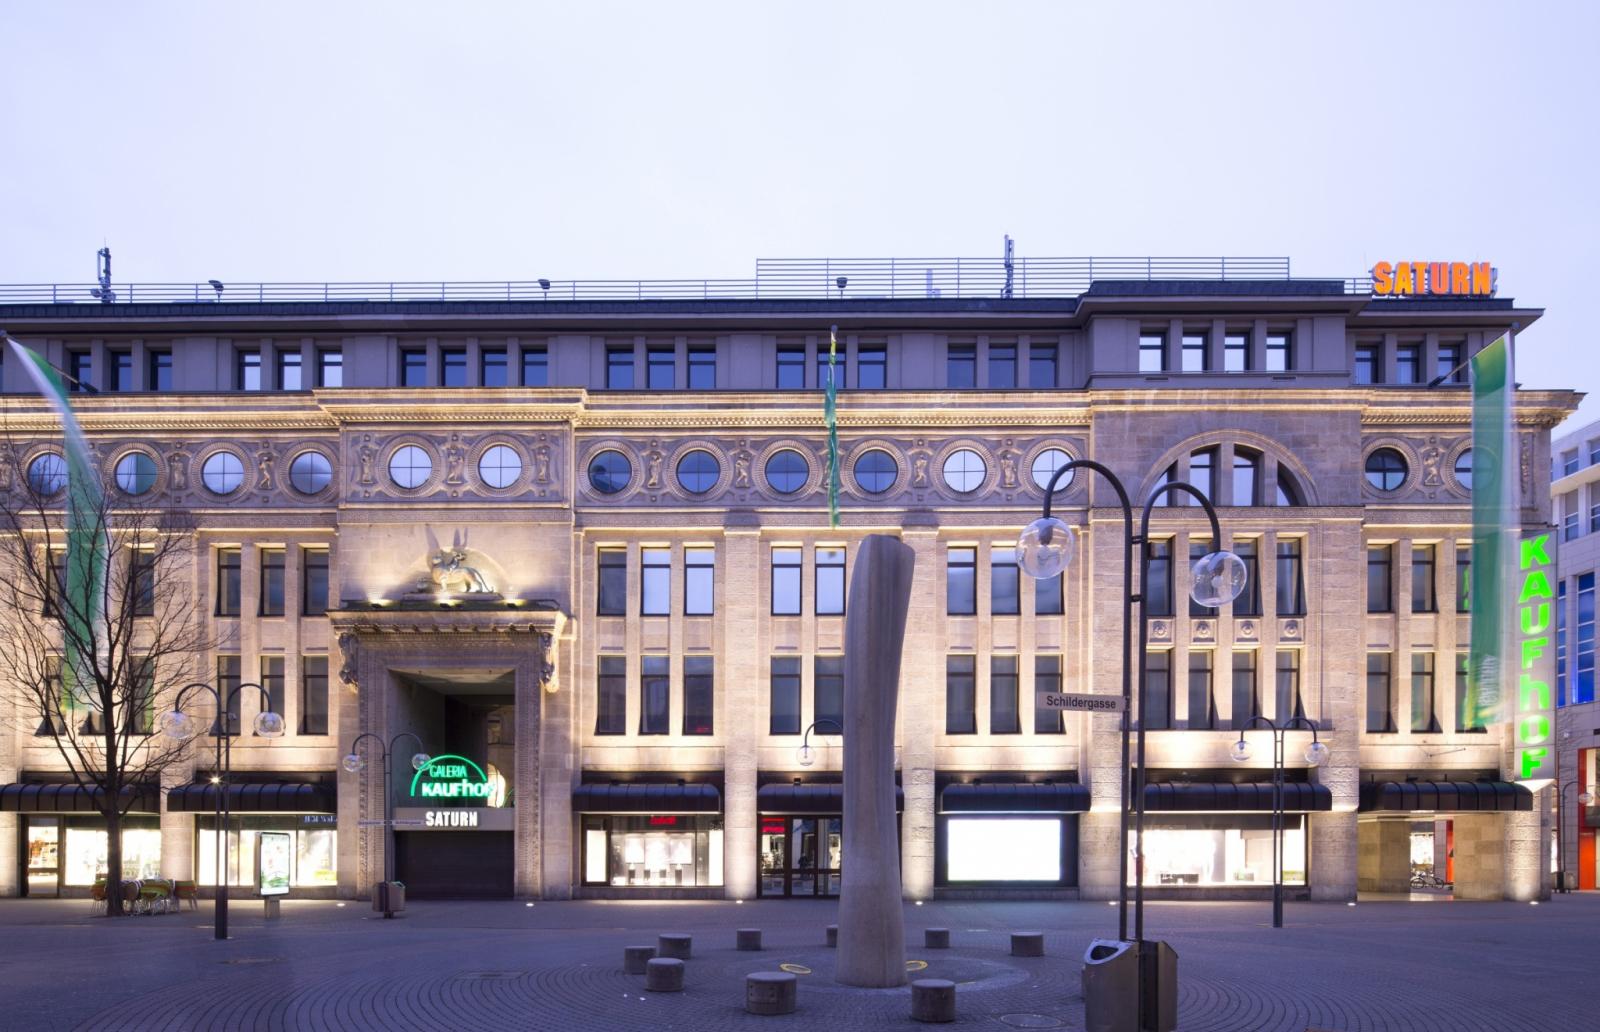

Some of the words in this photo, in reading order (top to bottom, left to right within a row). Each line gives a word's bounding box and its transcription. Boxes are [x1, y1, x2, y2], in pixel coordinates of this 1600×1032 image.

[1373, 261, 1491, 294] SATURN
[1047, 696, 1116, 710] Schildergasse
[429, 764, 468, 778] GALERIA
[426, 811, 477, 827] SATURN
